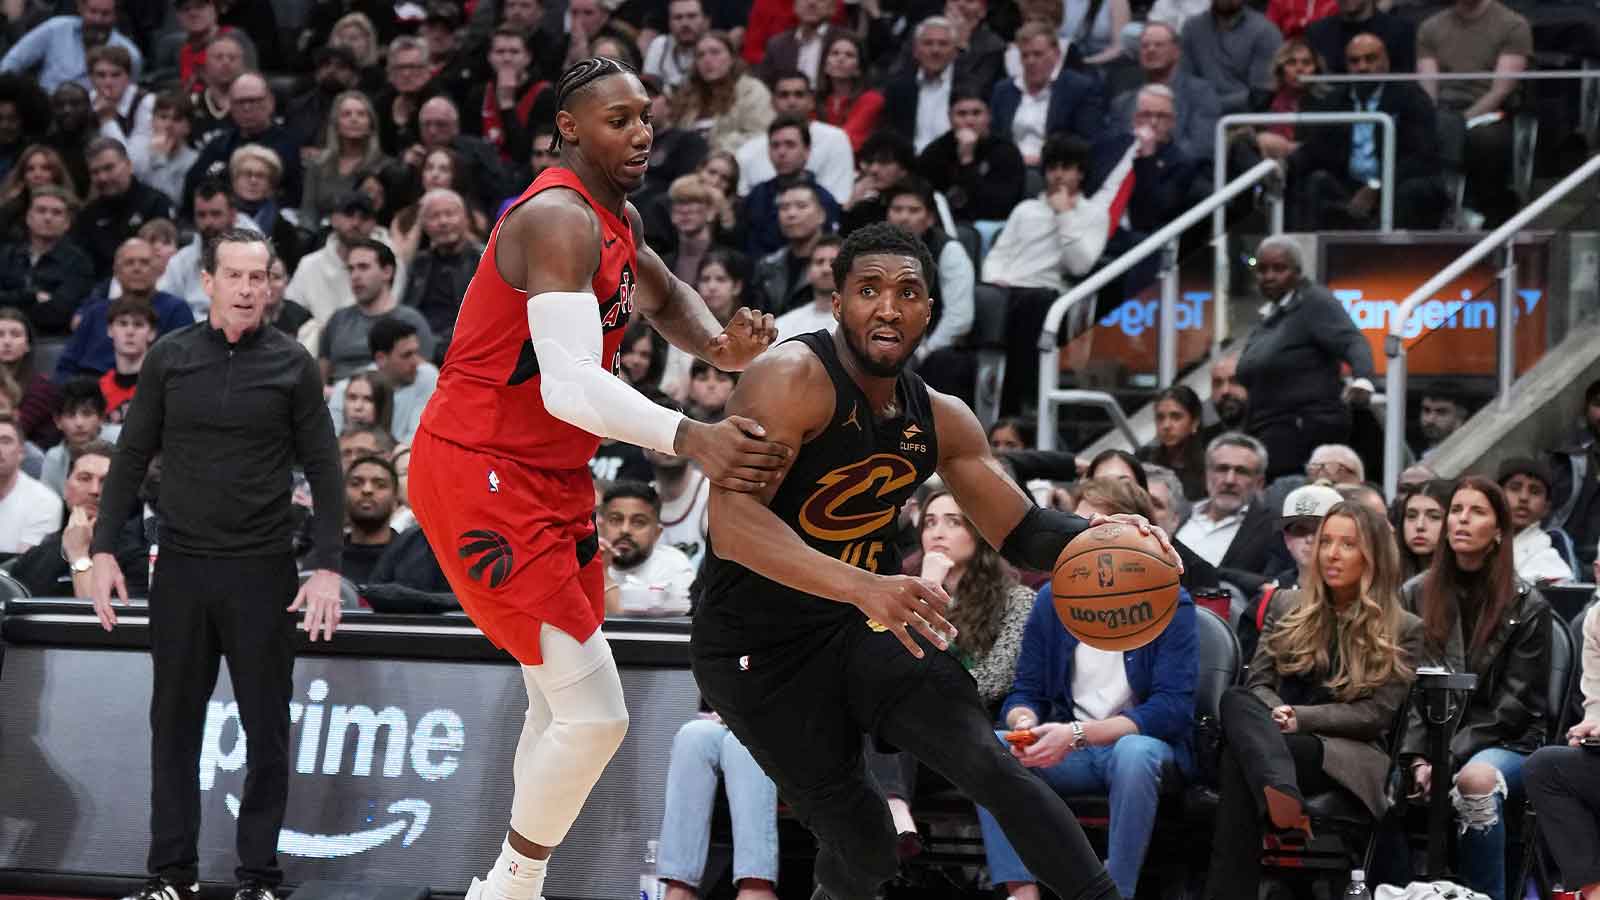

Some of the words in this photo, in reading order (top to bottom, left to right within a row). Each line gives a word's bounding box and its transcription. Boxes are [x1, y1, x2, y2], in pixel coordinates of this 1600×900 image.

[1332, 288, 1519, 339] Tangerin
[1070, 601, 1153, 629] Wilson
[199, 679, 465, 791] pime
